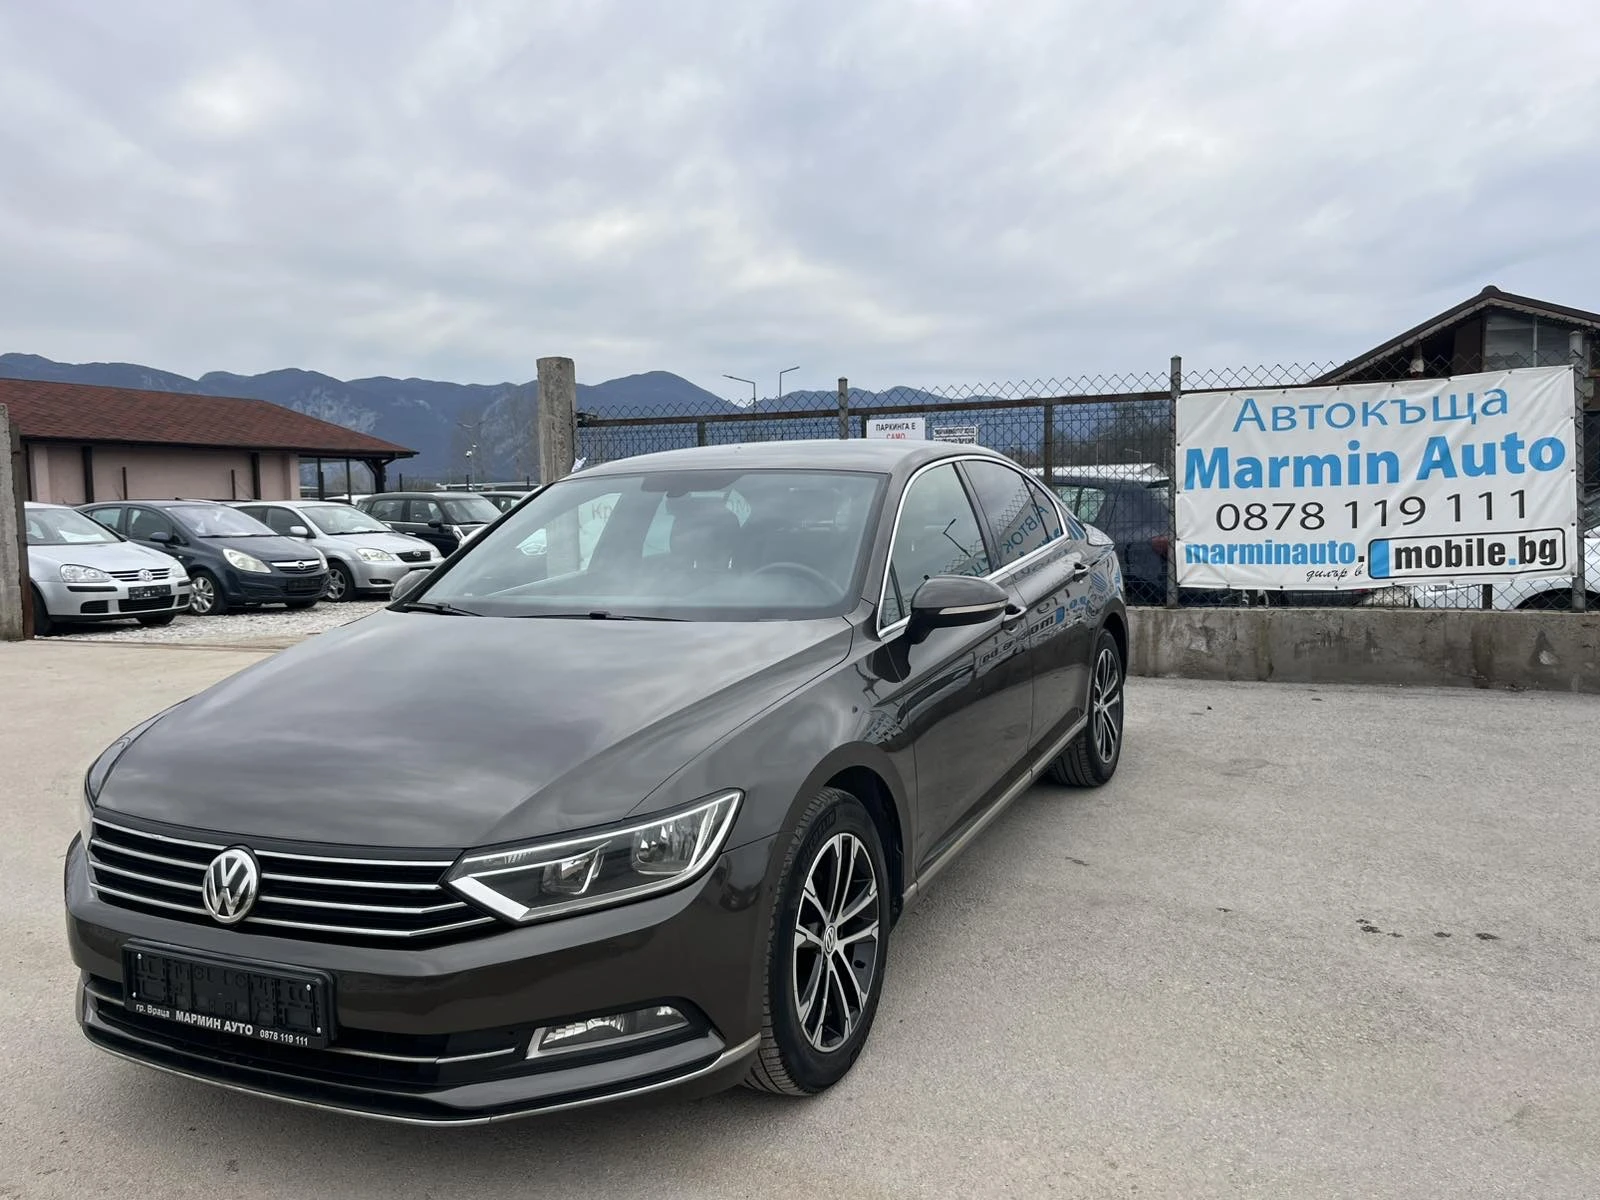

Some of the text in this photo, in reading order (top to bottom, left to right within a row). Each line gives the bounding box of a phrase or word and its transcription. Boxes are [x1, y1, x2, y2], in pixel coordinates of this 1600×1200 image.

[876, 423, 910, 432] ПАРКИНГА
[1232, 387, 1509, 433] Автокъща
[1184, 431, 1566, 491] Marmin Auto
[1215, 489, 1526, 531] 0878 119 111
[1394, 535, 1558, 569] mobile.bg
[147, 1004, 170, 1018] Враца
[175, 1010, 221, 1030] МАРМИН
[223, 1020, 254, 1036] АУТО
[259, 1029, 279, 1041] 0878
[280, 1033, 294, 1043] 119
[295, 1035, 308, 1047] 111
